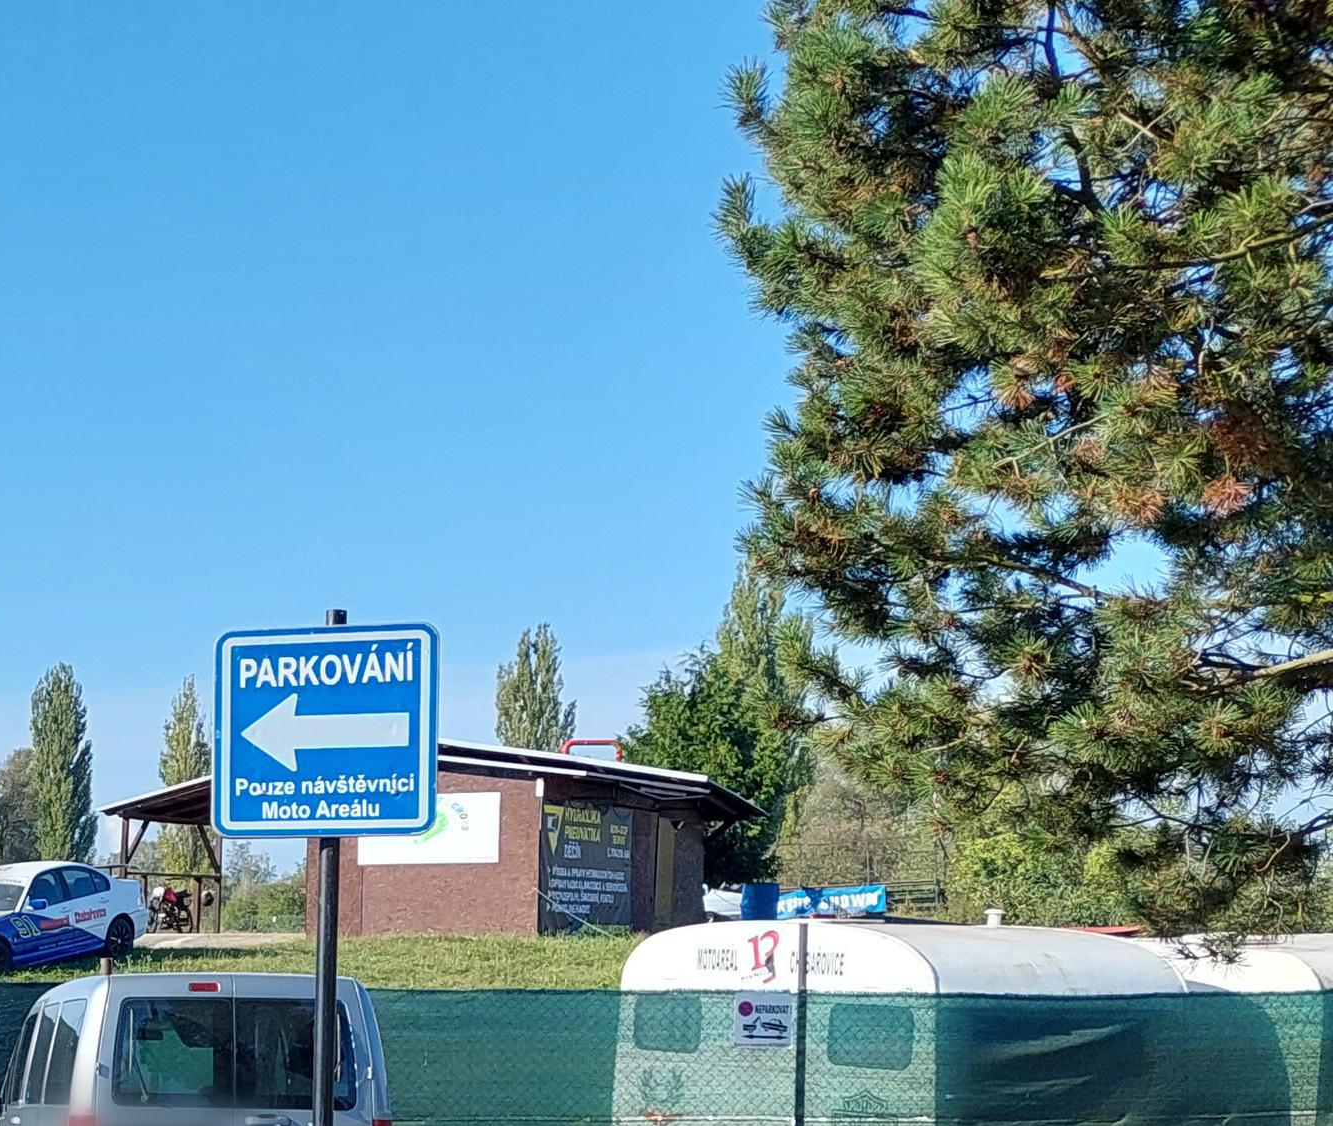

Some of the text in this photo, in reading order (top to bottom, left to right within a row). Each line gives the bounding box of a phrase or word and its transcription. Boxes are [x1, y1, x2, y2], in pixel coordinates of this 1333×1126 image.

[239, 642, 414, 689] PARKOVÁNÍ
[235, 773, 415, 797] Pouze návštěvníci
[262, 799, 381, 819] Moto Areálu
[10, 915, 42, 939] 91
